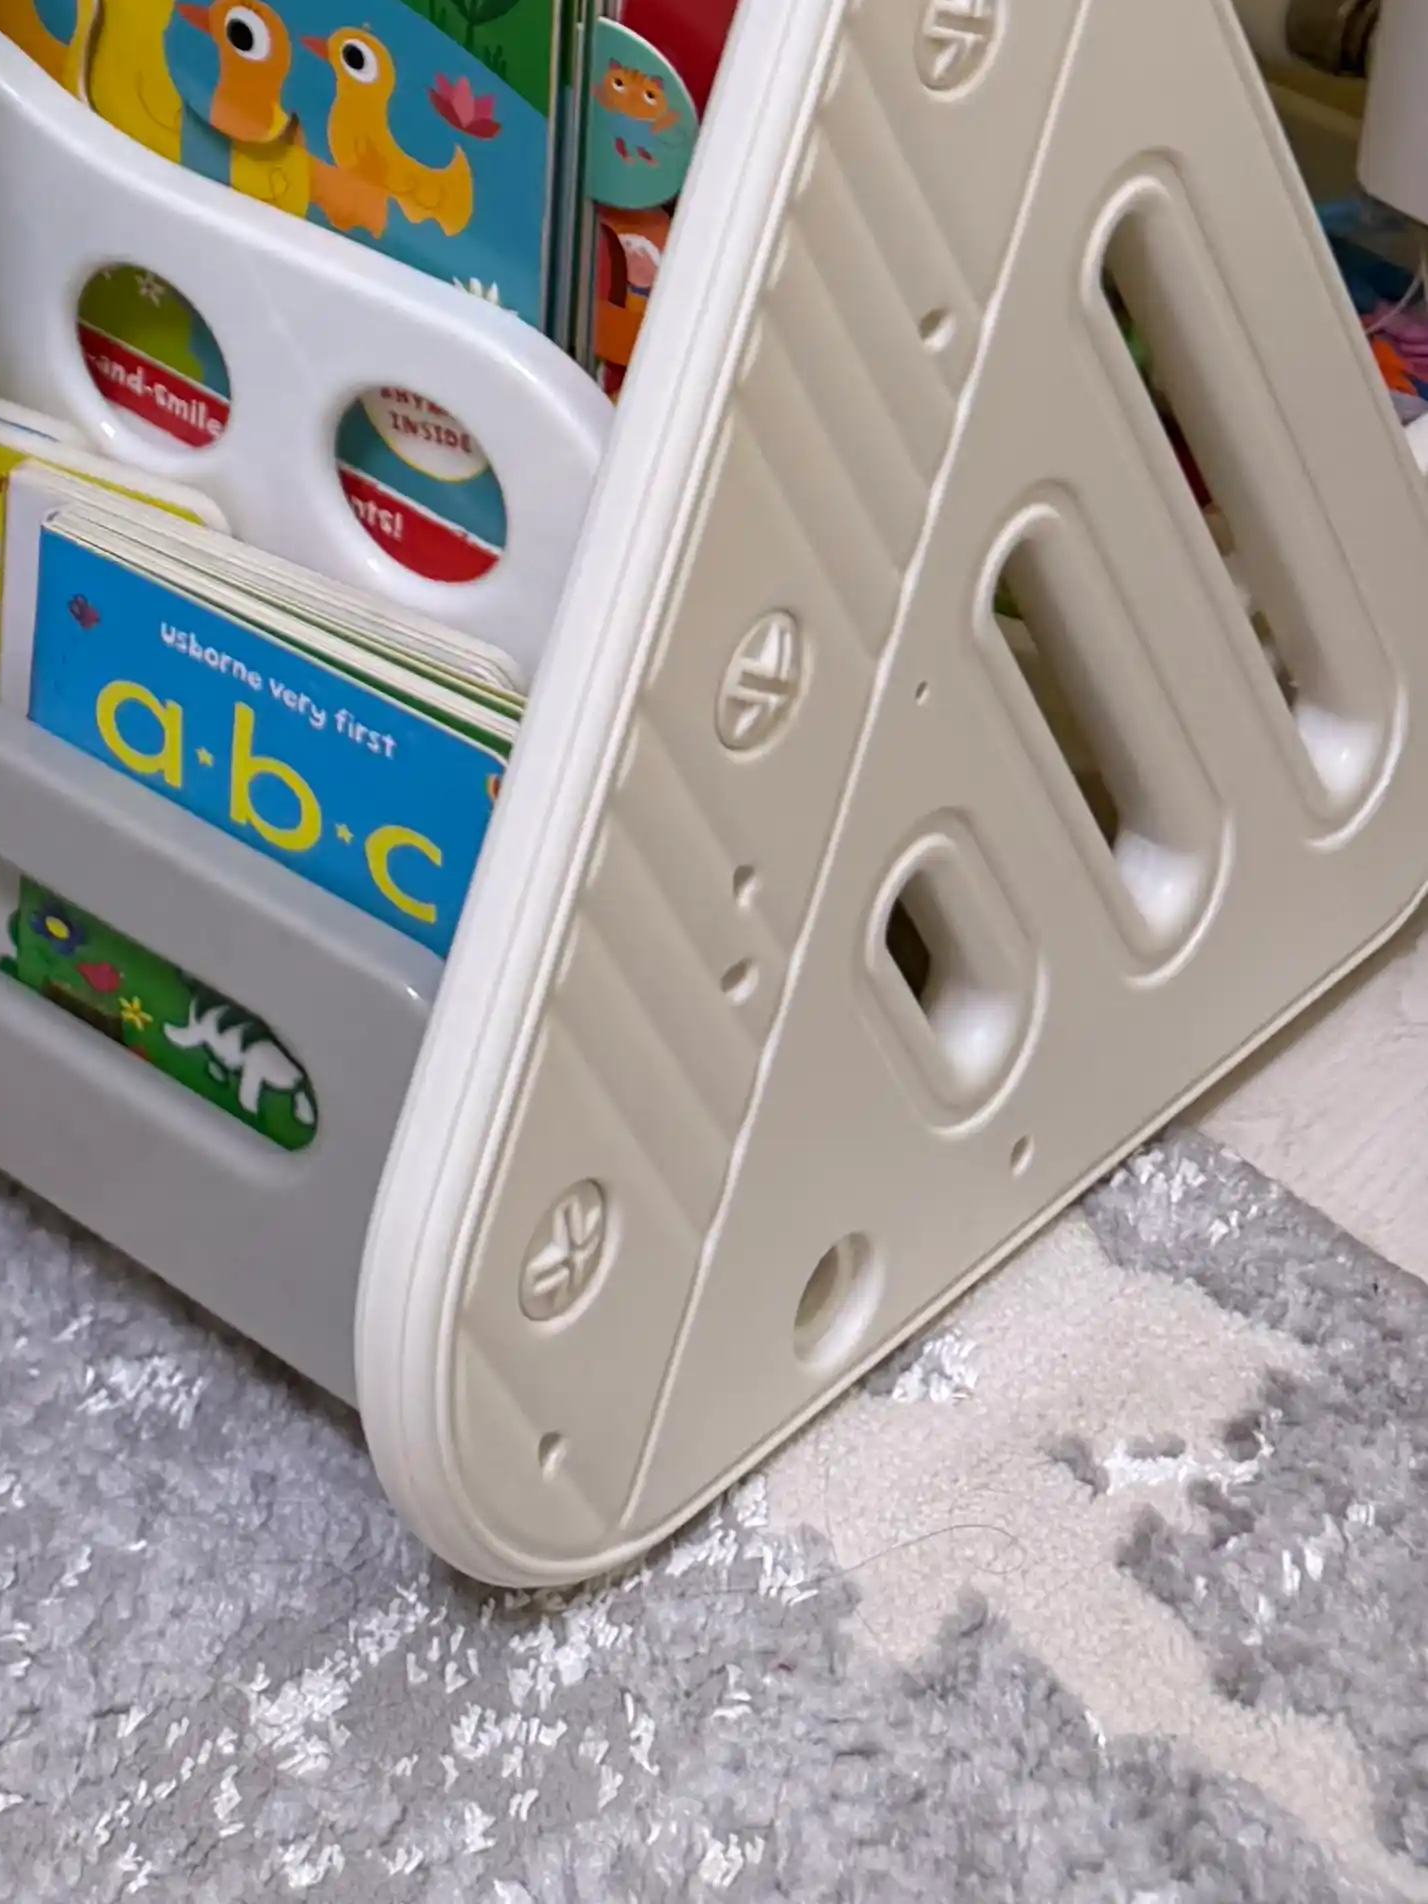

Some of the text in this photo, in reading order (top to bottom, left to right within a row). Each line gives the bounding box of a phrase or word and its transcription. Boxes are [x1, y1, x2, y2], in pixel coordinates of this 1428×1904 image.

[389, 410, 473, 453] INSIDE
[160, 622, 398, 761] usborne very first
